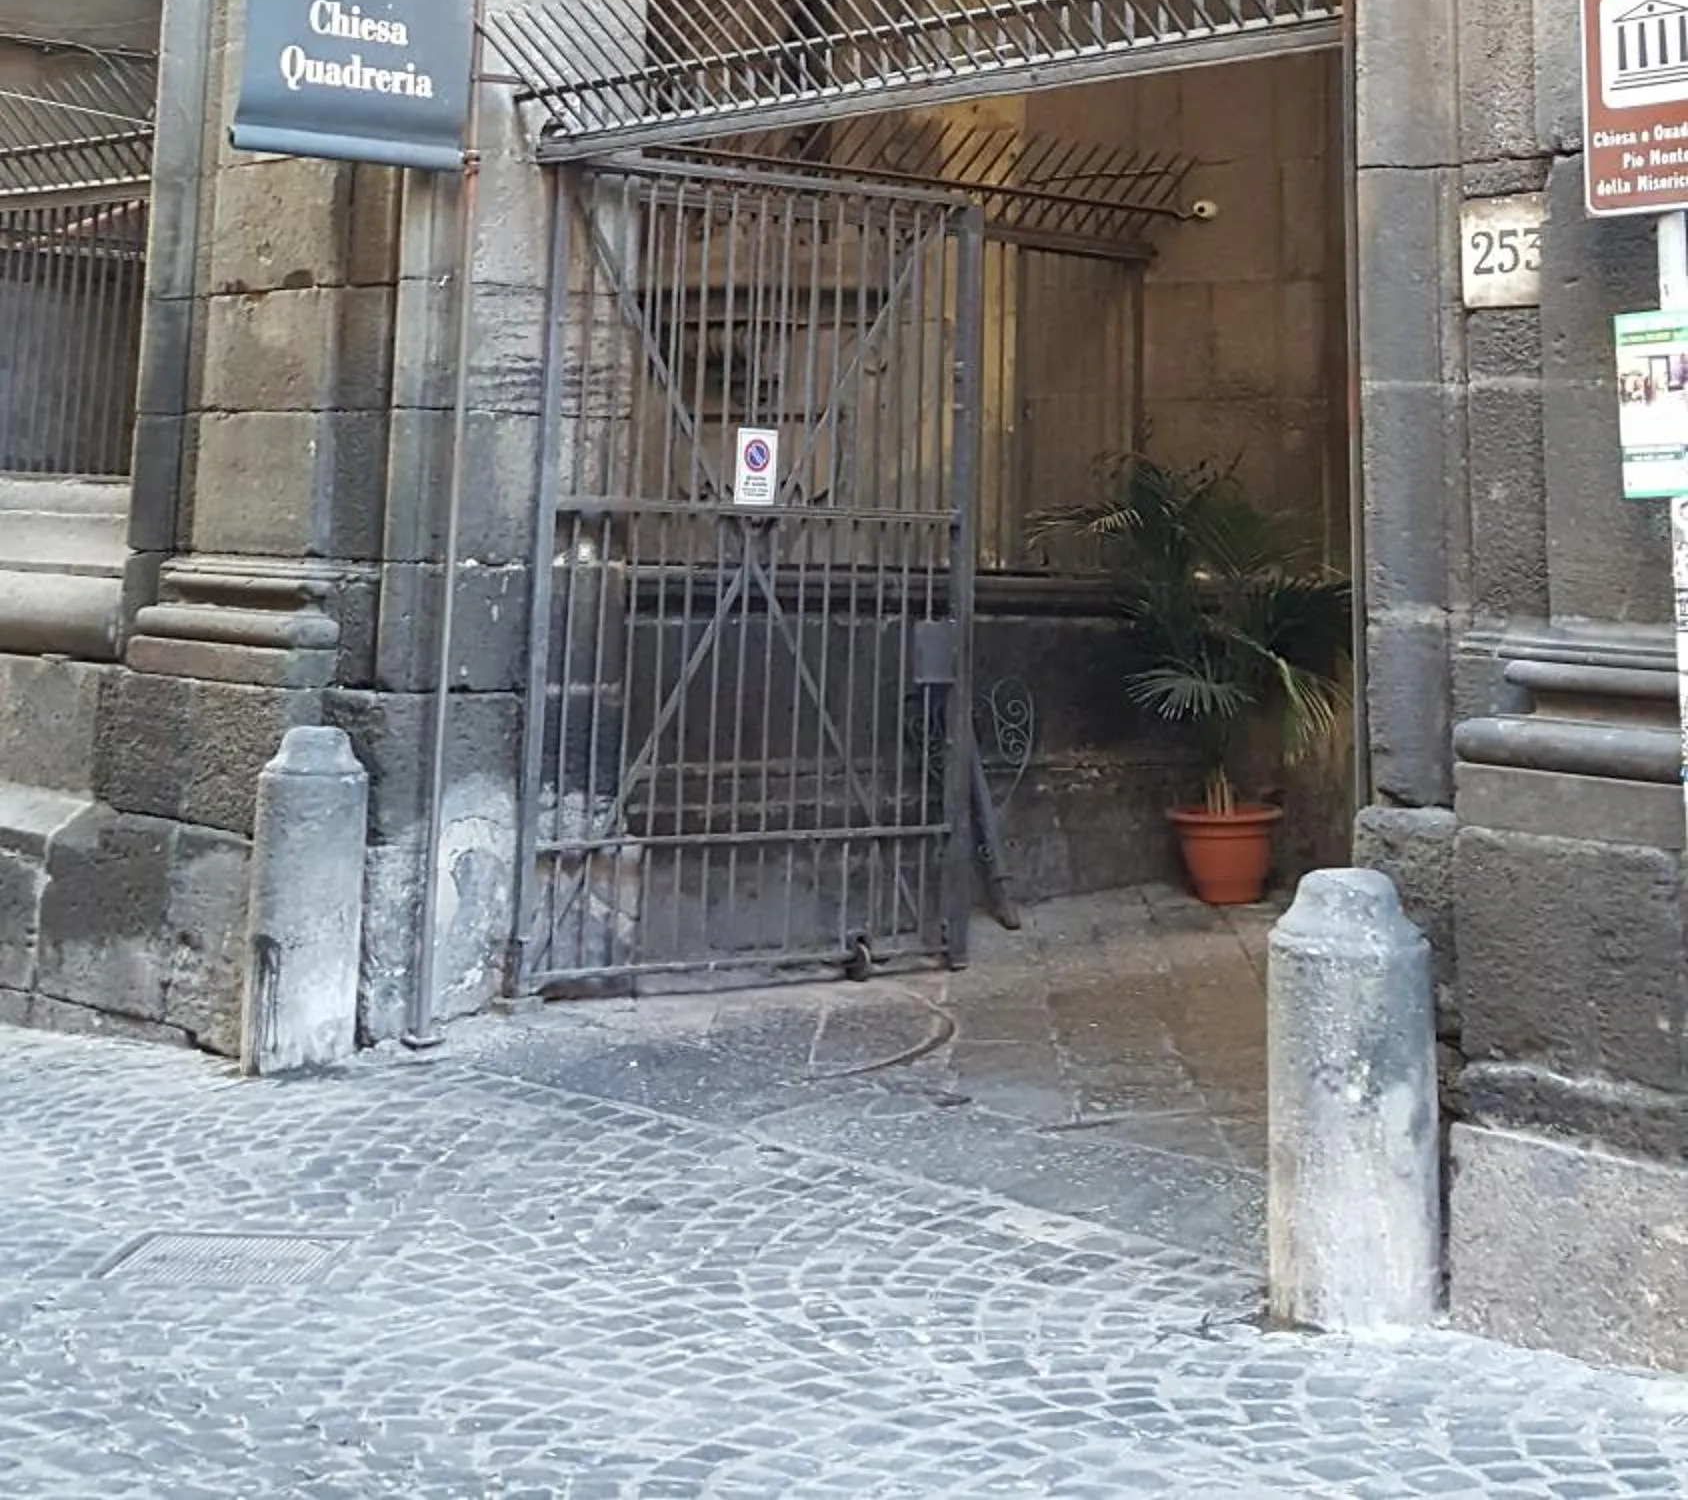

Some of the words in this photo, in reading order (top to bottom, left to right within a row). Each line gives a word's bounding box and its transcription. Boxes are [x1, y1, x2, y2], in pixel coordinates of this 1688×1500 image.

[279, 45, 434, 100] Quadreria
[1593, 130, 1637, 148] Chiesa
[1622, 151, 1645, 169] Pio
[1596, 178, 1631, 197] della
[1471, 227, 1543, 276] 253
